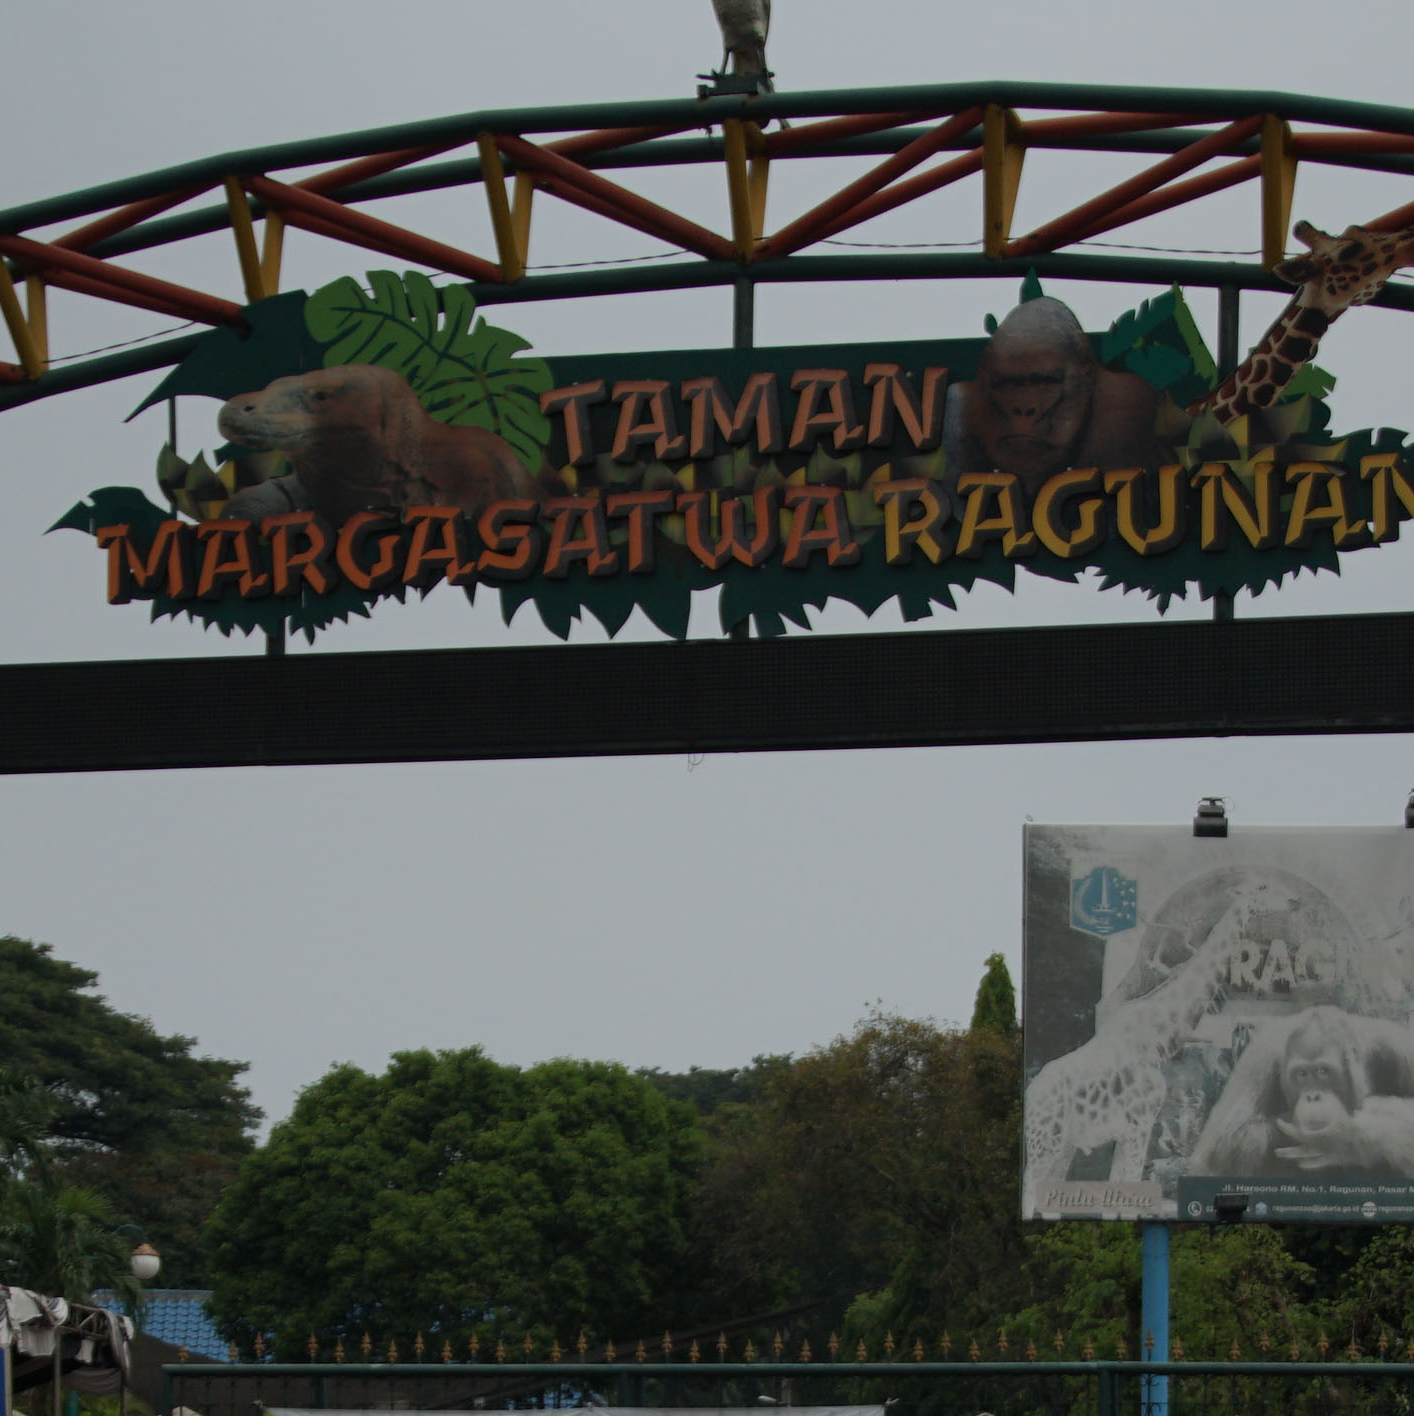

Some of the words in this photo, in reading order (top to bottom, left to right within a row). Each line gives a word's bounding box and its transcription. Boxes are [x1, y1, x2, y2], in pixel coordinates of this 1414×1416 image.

[540, 363, 948, 466] TAMAN
[96, 484, 864, 604] MARGASATWA
[1236, 1184, 1278, 1193] Harsono
[1330, 1186, 1376, 1195] Ragunan,
